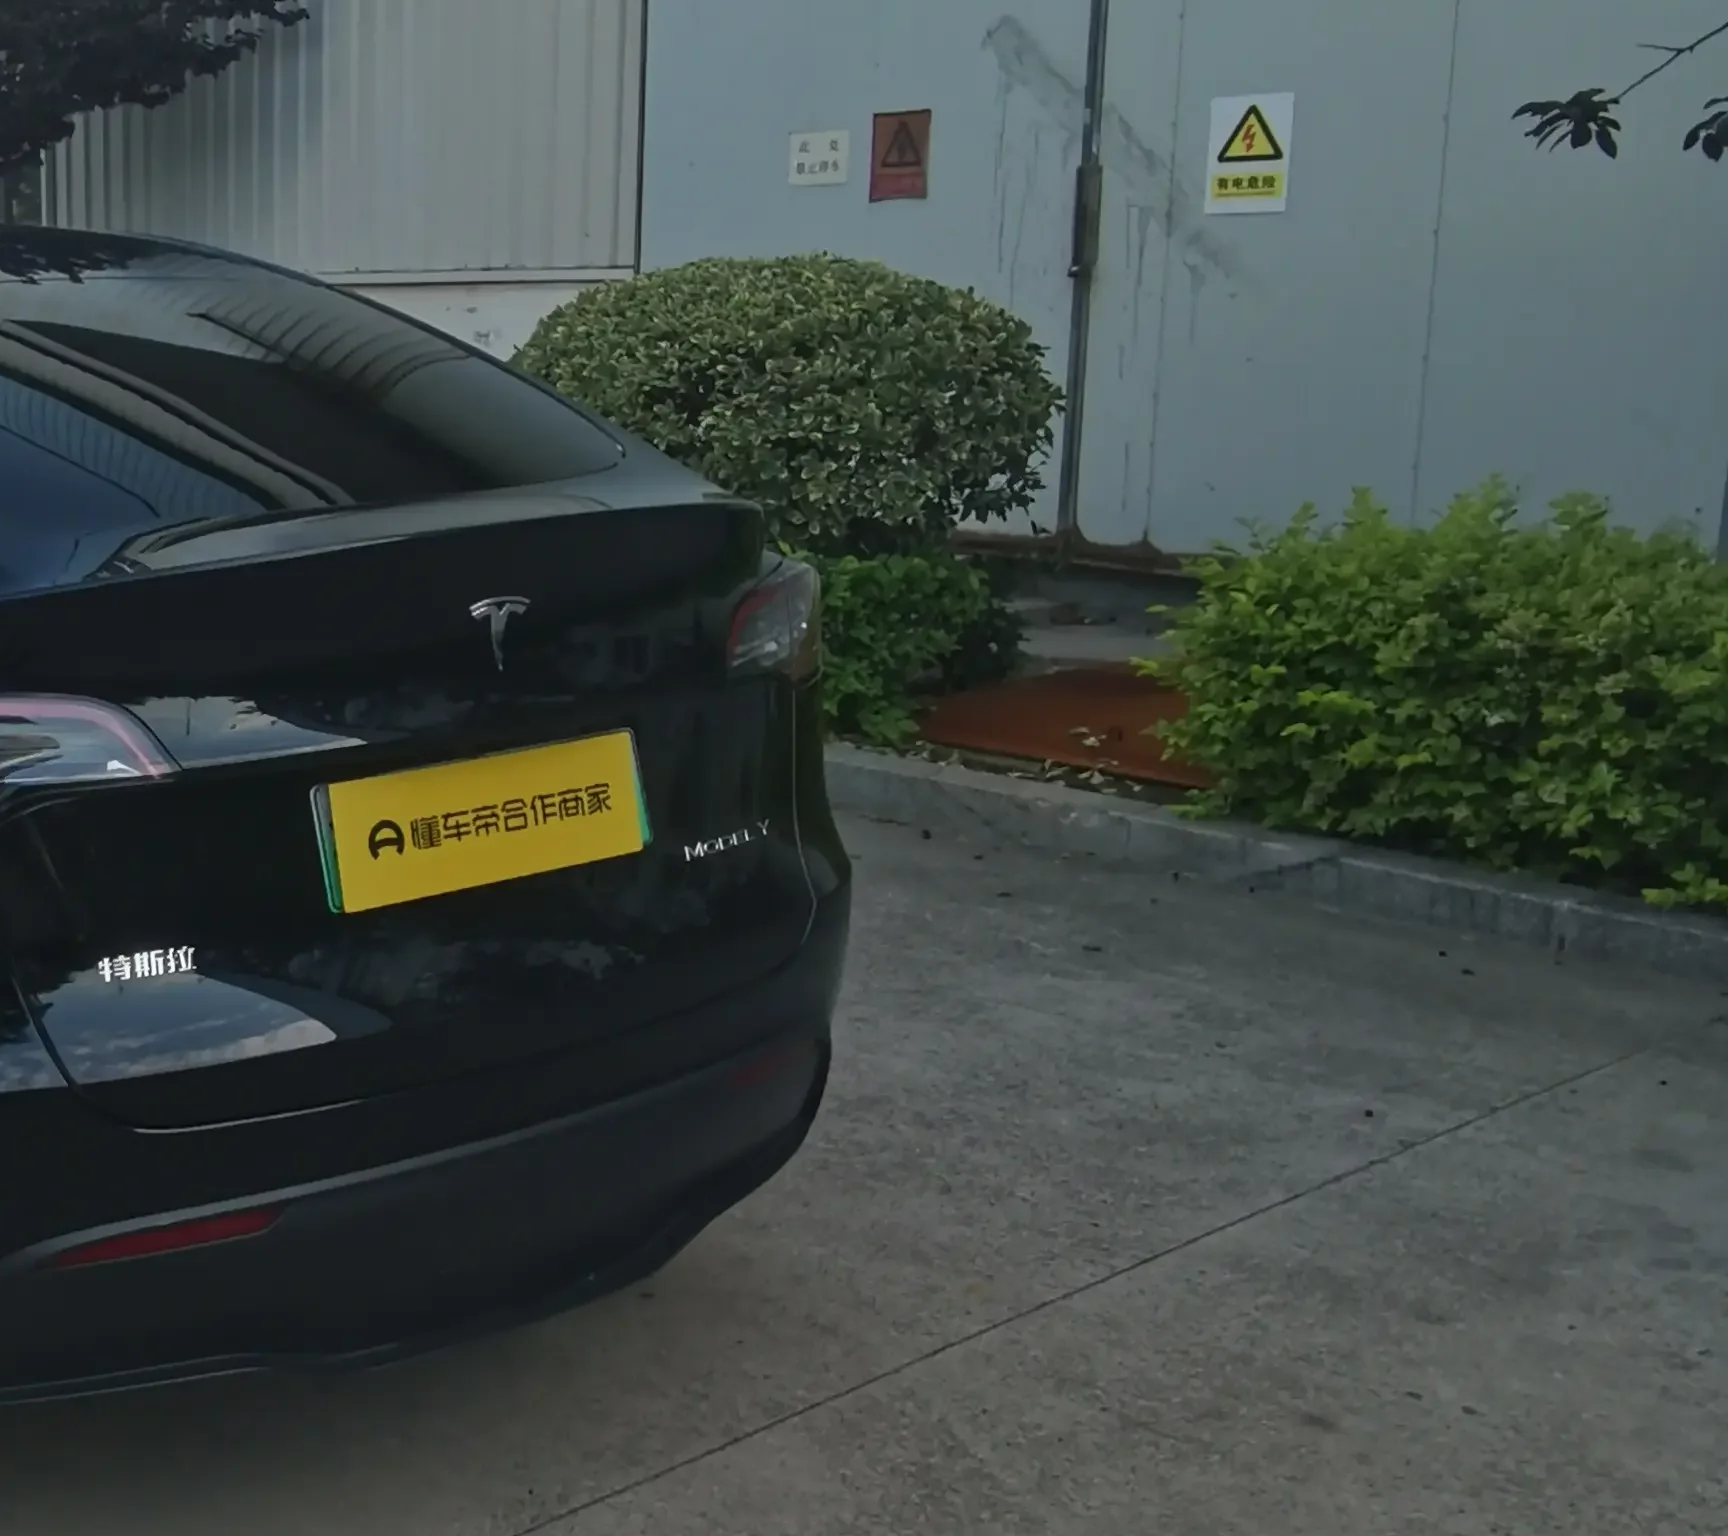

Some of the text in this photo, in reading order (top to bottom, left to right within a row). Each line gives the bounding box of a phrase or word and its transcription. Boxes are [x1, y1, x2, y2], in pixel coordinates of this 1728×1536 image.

[1216, 175, 1276, 191] 有电危险
[410, 782, 612, 850] 懂车帝合作商家
[756, 818, 770, 835] Y
[98, 945, 198, 983] 特斯拉
